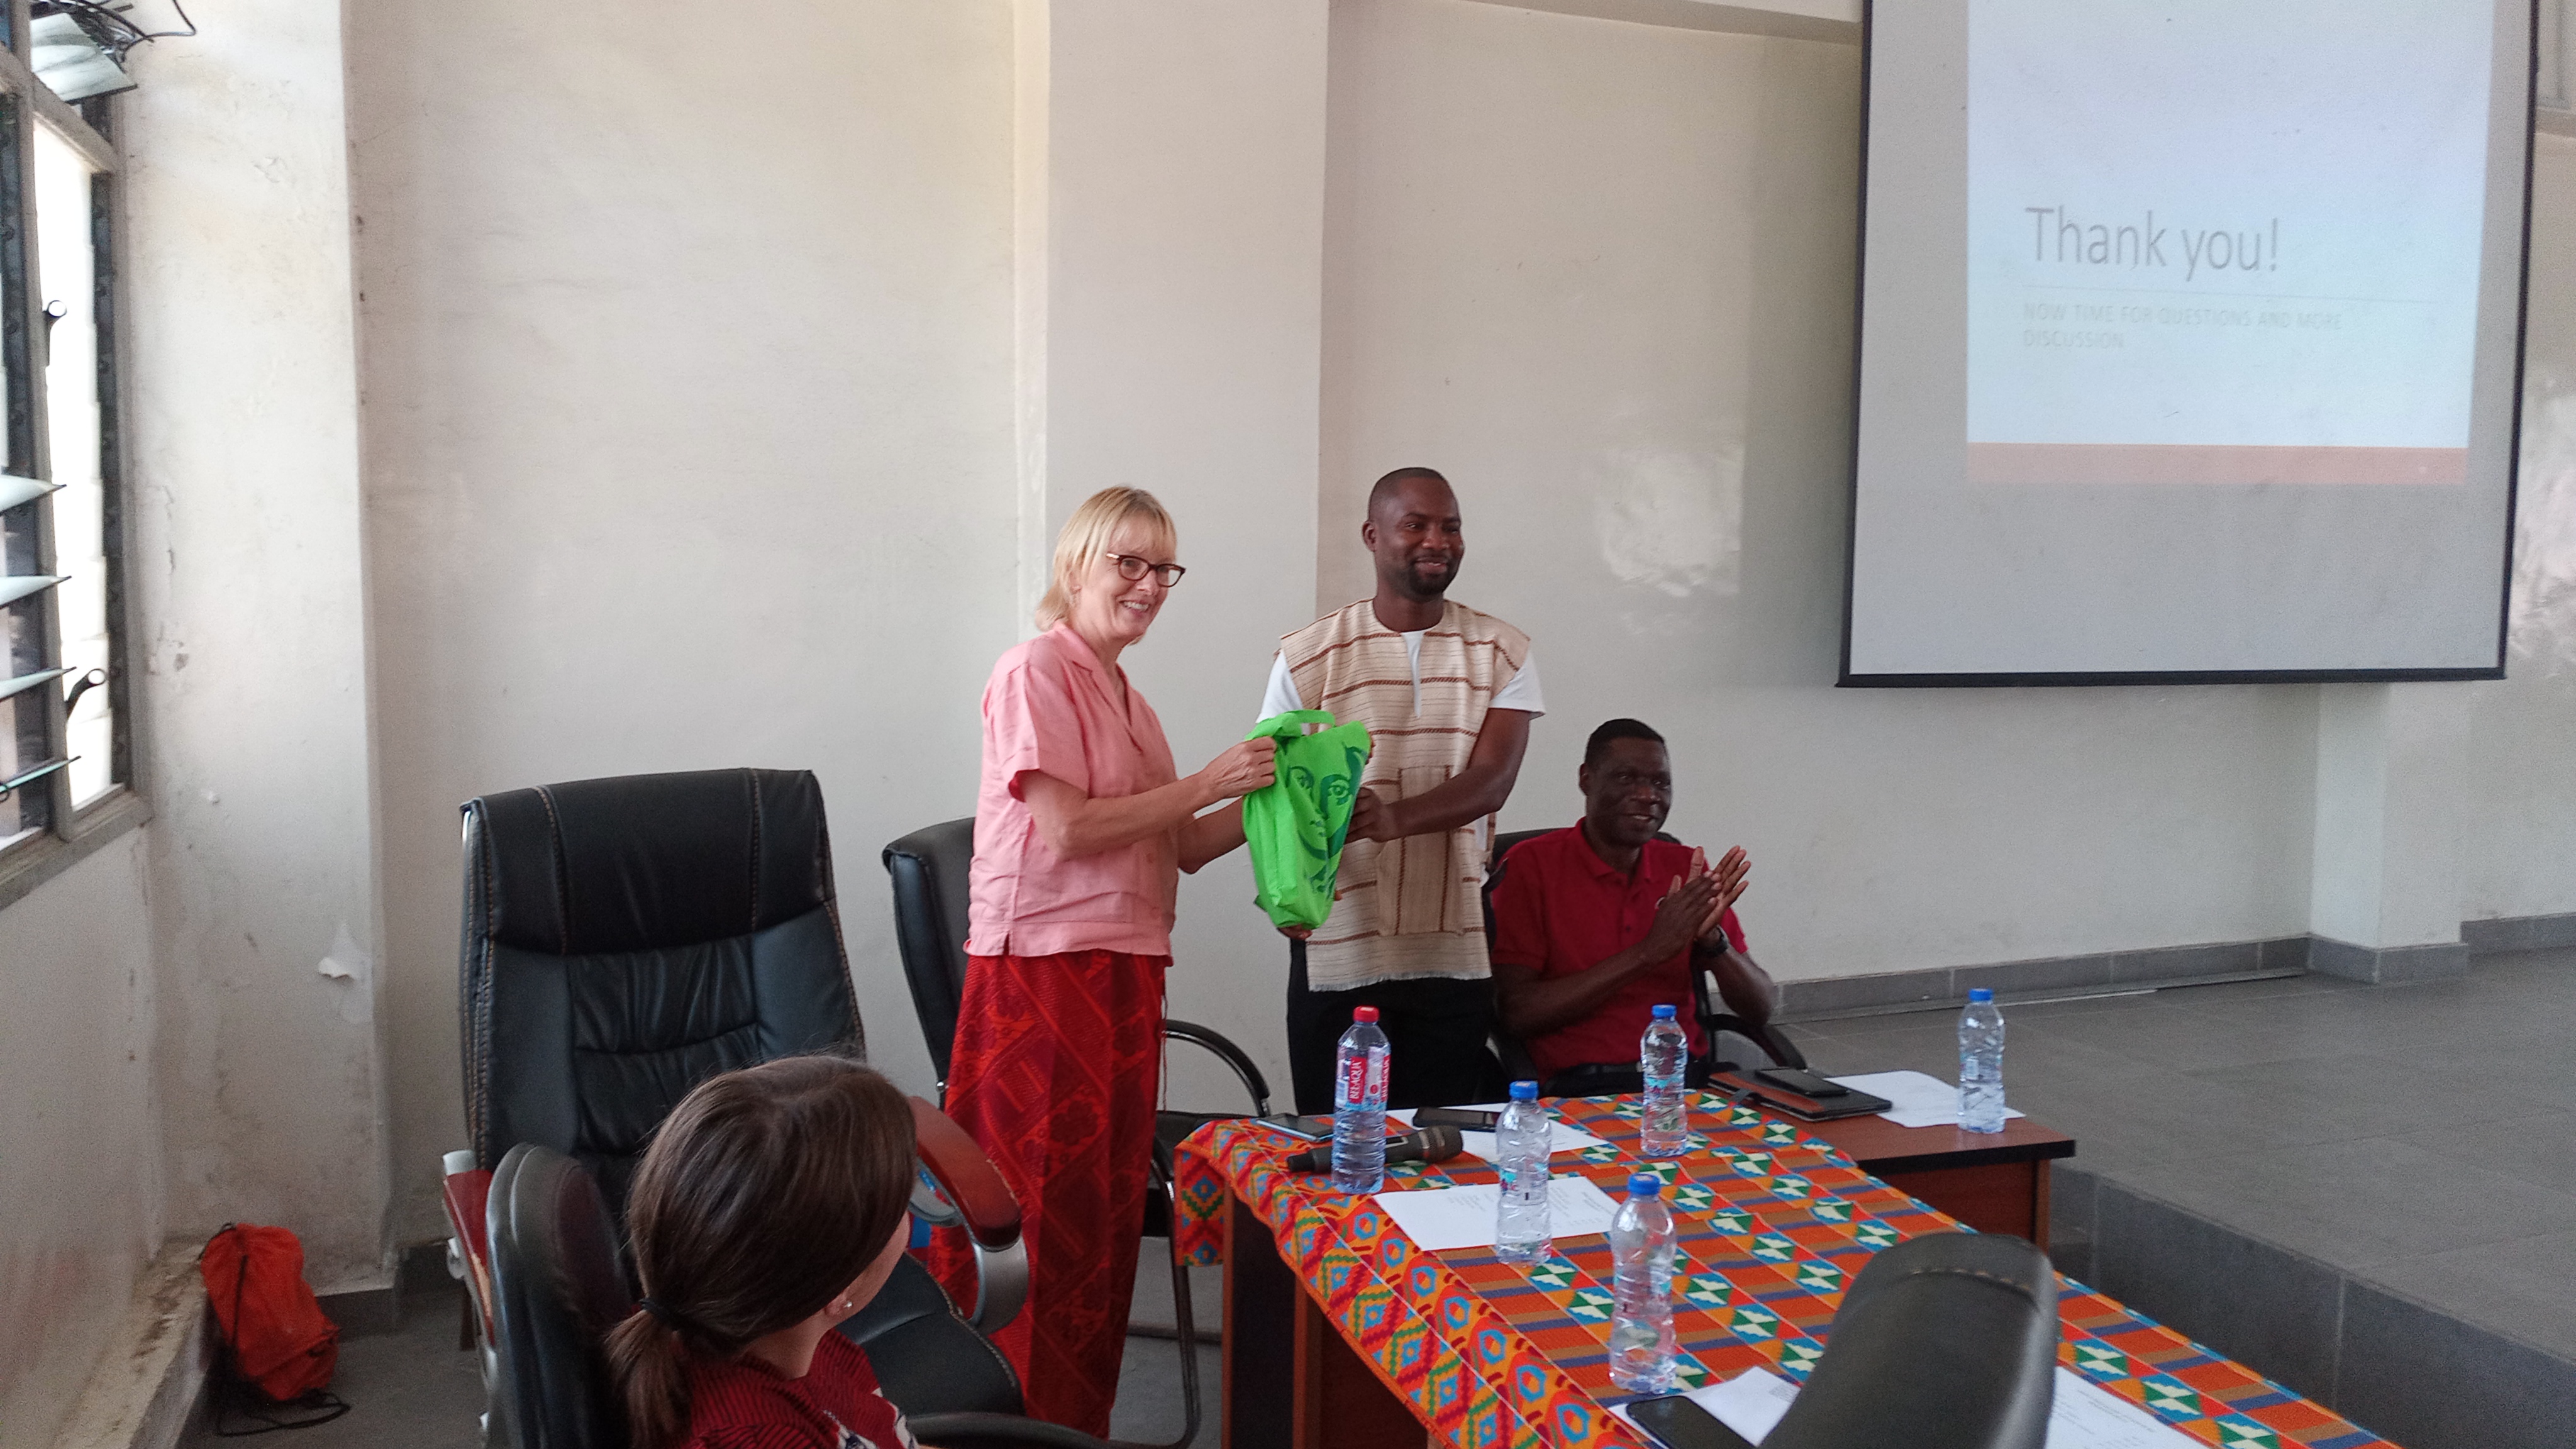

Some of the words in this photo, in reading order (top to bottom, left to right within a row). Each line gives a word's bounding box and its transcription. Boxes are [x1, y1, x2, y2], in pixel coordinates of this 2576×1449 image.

[2024, 204, 2167, 267] Thank
[2180, 216, 2278, 282] you!
[2023, 303, 2065, 321] NOW
[2074, 304, 2114, 323] TIME
[2121, 305, 2153, 324] FOR
[2158, 307, 2252, 326] QUESTIONS
[2258, 311, 2292, 328] AND
[2297, 312, 2343, 330] MORE
[2023, 329, 2124, 349] DISCUSSION
